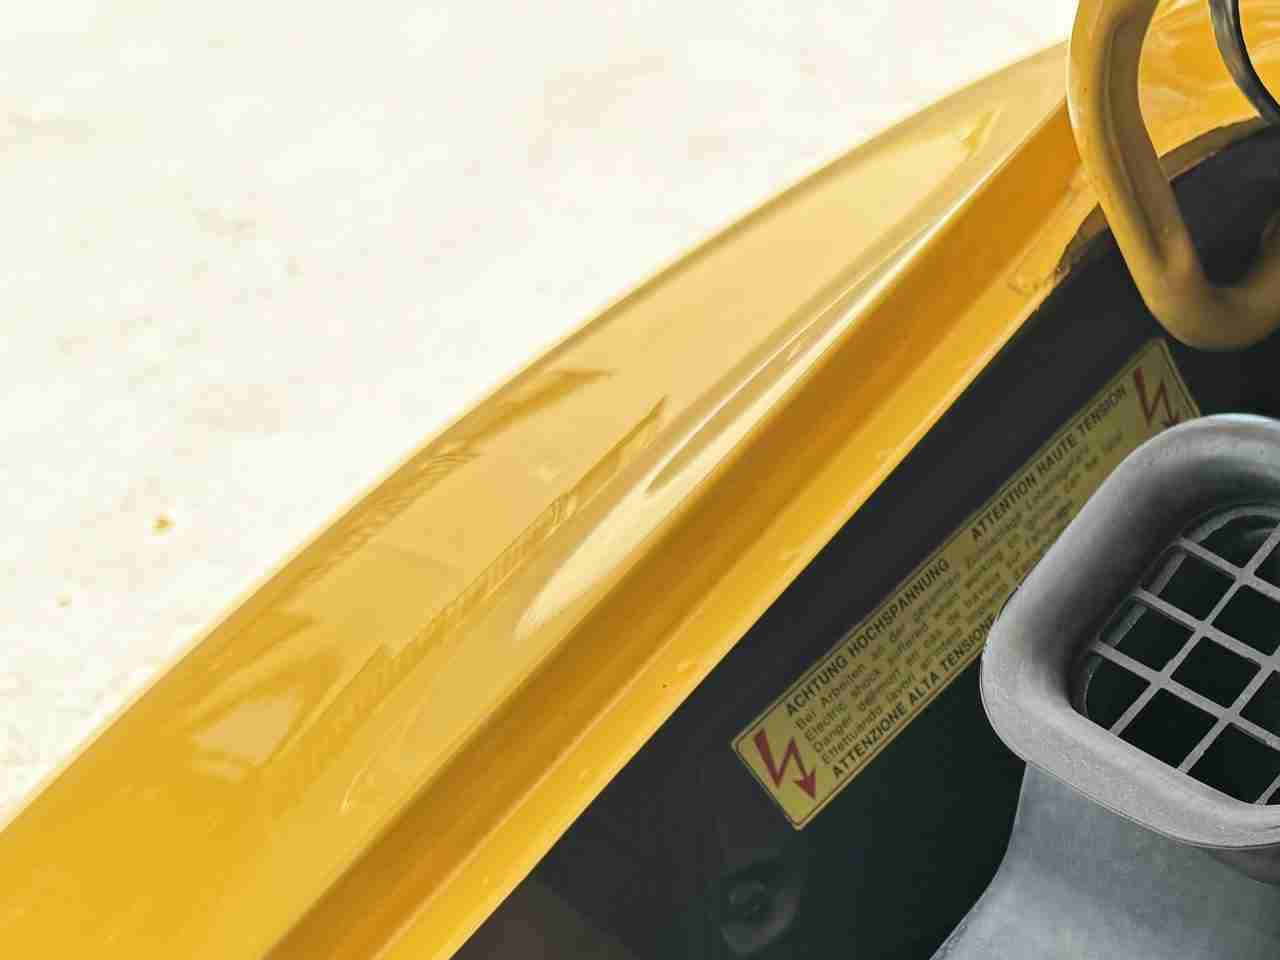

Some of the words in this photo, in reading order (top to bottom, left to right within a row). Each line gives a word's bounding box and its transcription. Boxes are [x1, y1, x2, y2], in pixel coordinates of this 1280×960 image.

[970, 472, 1036, 540] ATTENTION
[1036, 433, 1076, 476] HAUTE
[1077, 384, 1126, 436] TENSION
[784, 653, 848, 717] ACHTUNG
[847, 556, 949, 657] HOCHSPANNUNG
[829, 702, 907, 779] ATTENZIONE
[906, 669, 940, 706] ALTA
